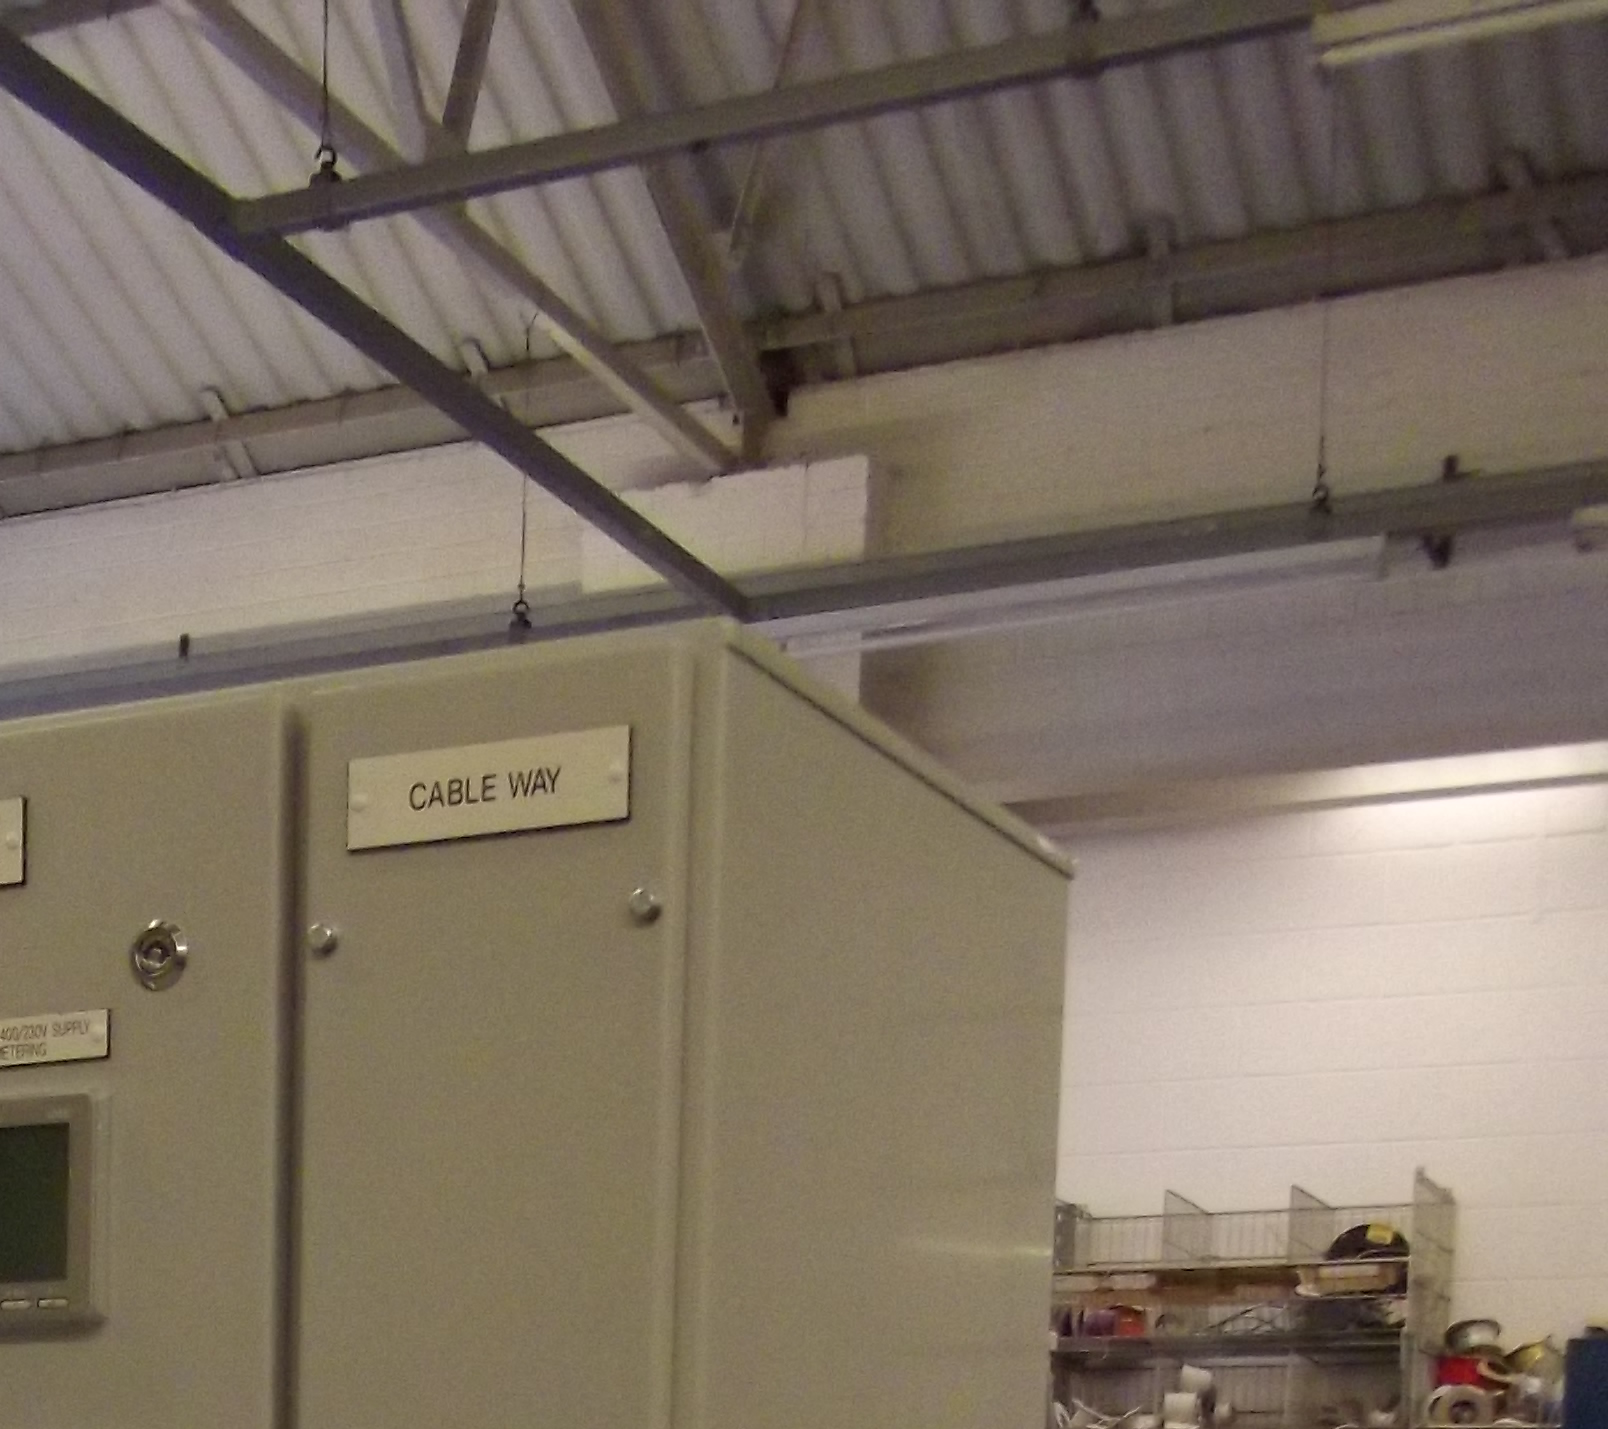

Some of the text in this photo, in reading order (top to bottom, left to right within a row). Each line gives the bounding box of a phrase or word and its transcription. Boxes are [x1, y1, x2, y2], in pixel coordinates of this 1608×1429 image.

[408, 766, 562, 812] CABLE WAY
[51, 1019, 90, 1037] SUPPLY
